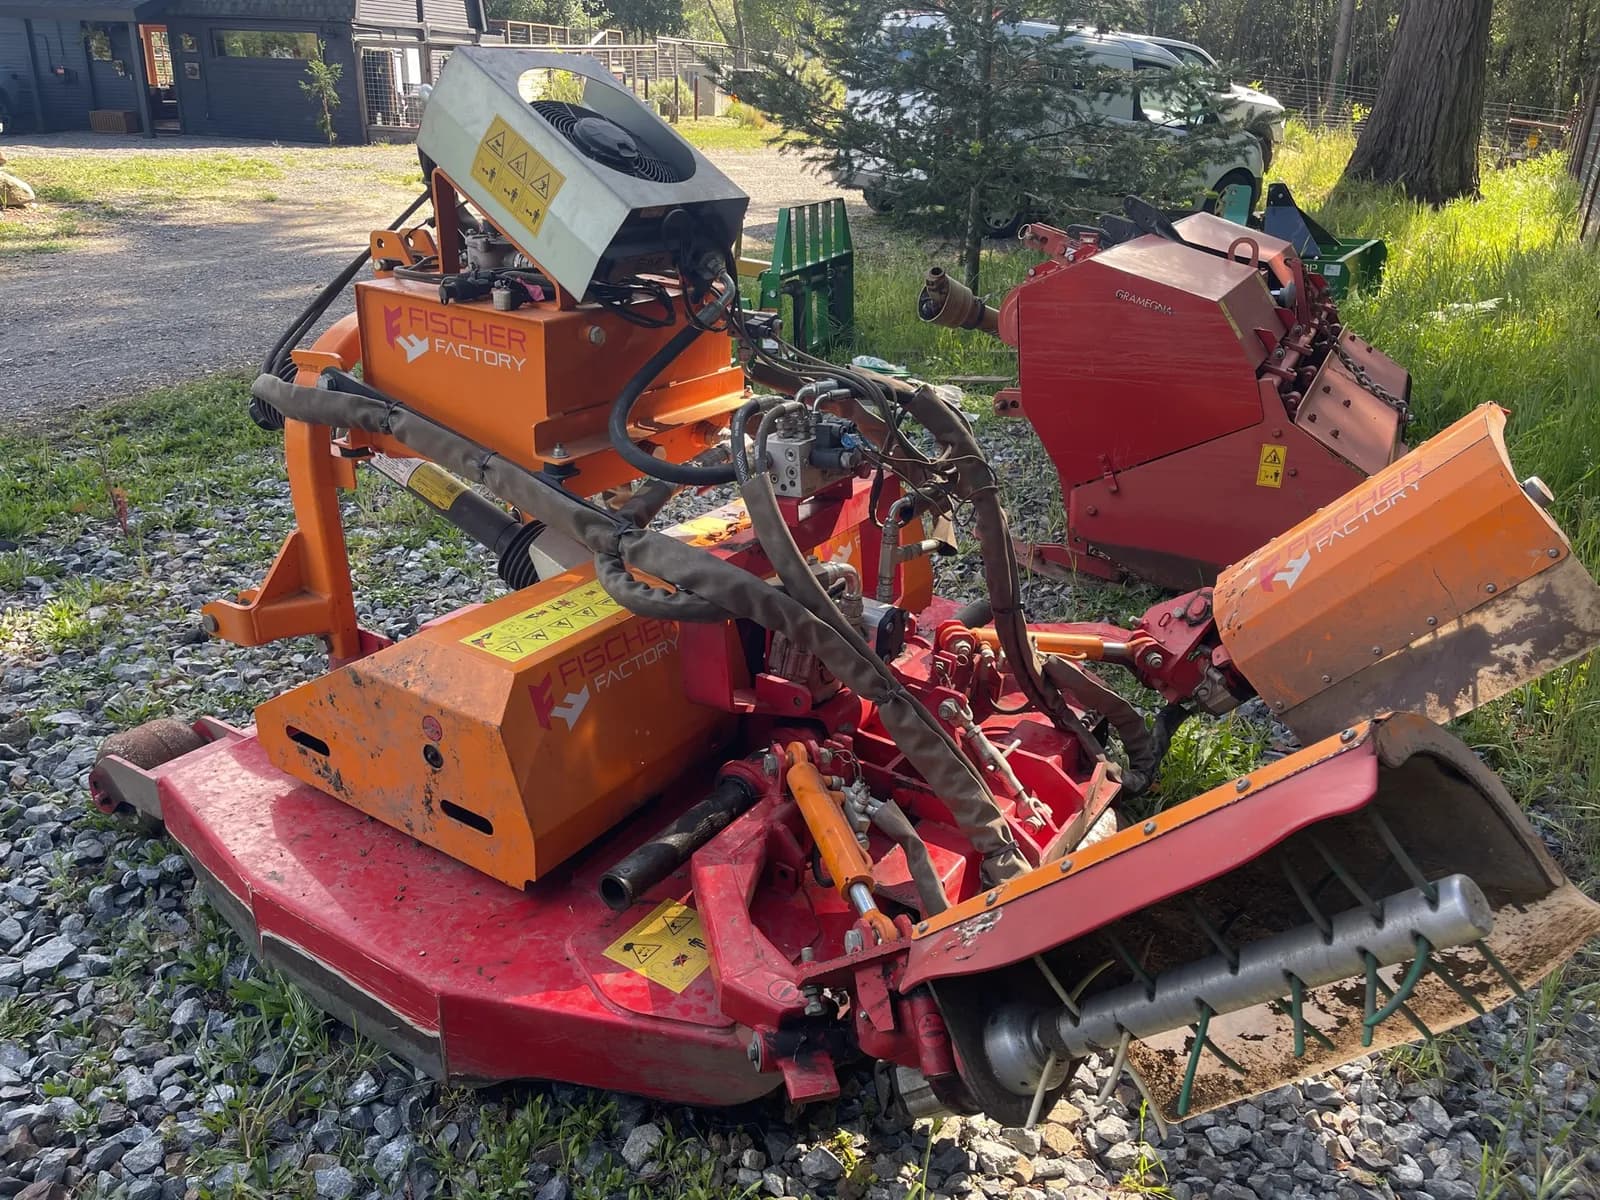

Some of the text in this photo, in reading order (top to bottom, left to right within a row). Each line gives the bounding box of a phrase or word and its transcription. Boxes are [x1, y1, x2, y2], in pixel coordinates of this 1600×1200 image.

[408, 307, 527, 353] FISCHER
[435, 338, 527, 372] FACTORY
[1287, 461, 1423, 557] FISCHER
[1315, 481, 1421, 553] FACTORY
[593, 631, 680, 694] FACTORY
